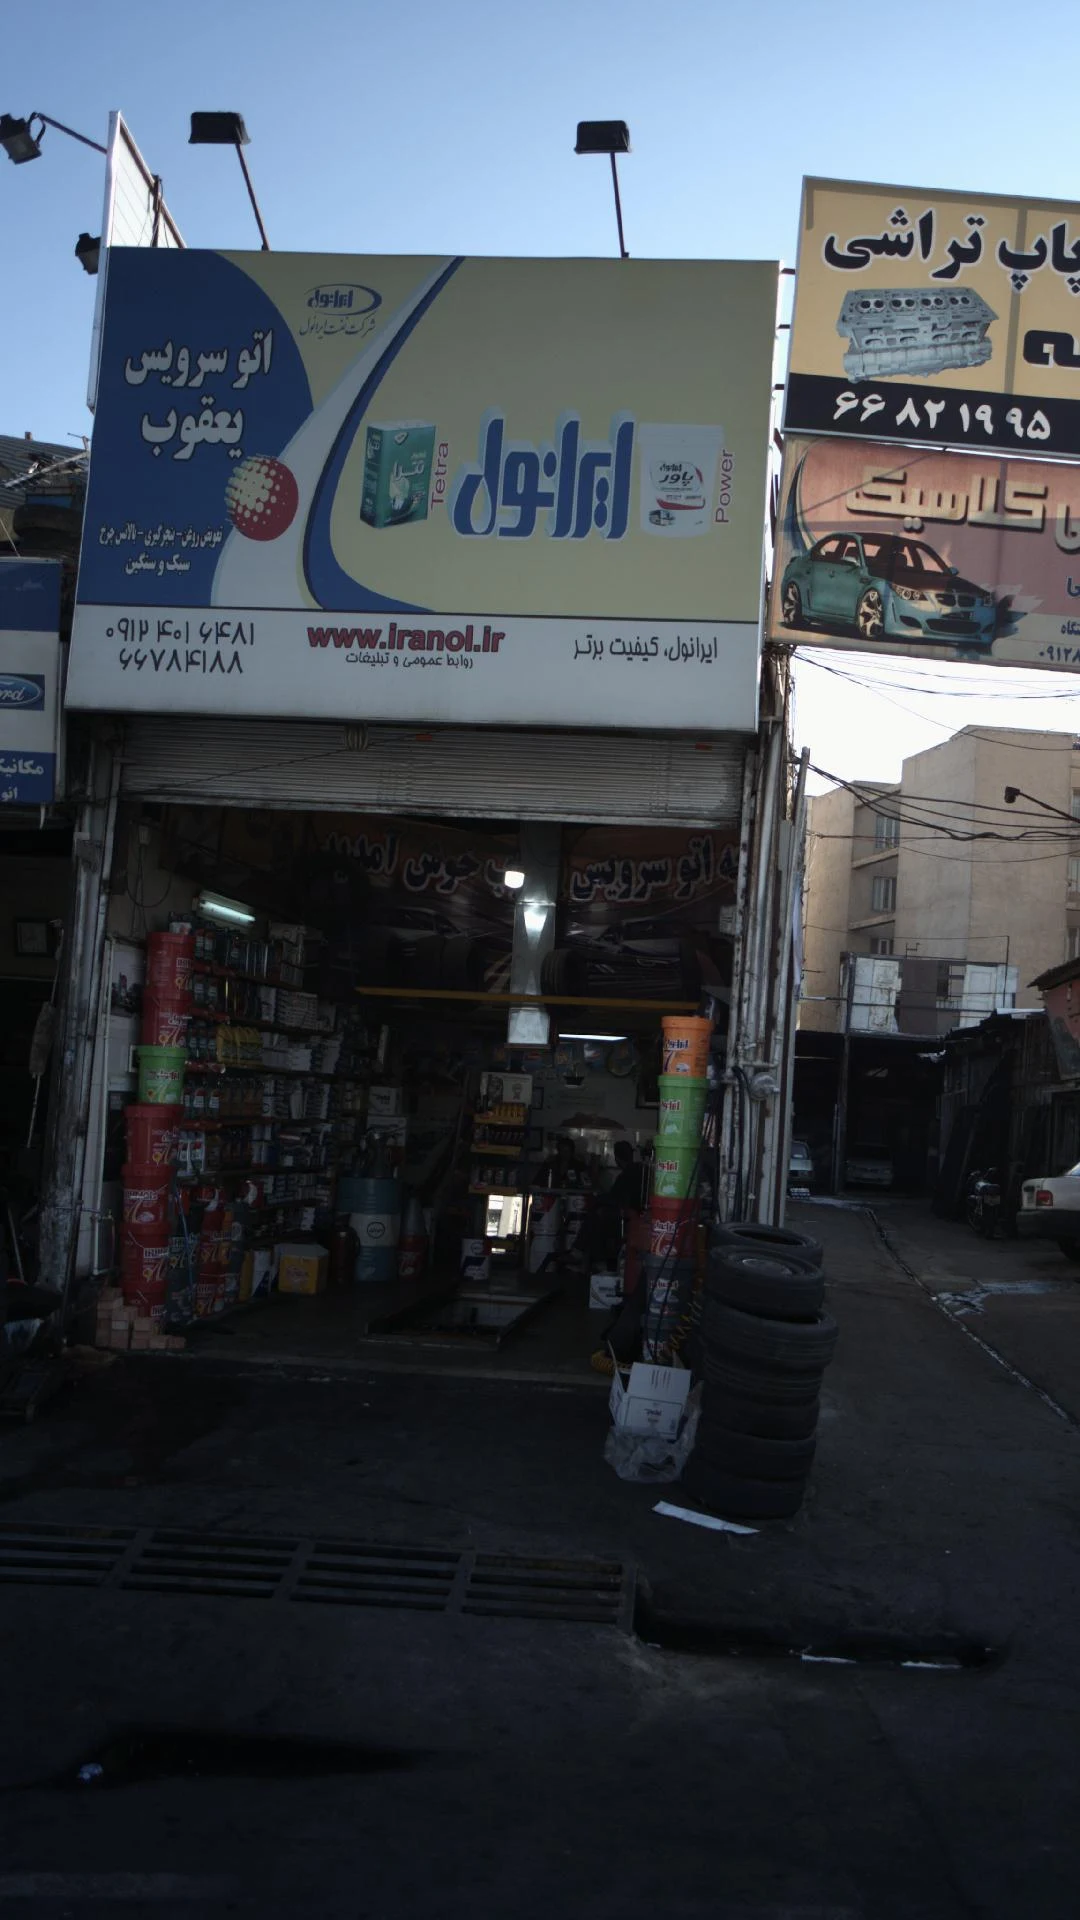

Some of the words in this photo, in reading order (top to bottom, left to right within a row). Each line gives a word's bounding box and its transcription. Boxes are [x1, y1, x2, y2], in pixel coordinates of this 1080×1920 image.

[824, 208, 985, 280] تراشی
[299, 315, 328, 340] ایرانول
[323, 316, 348, 335] نفت
[345, 311, 377, 339] شرکت
[124, 339, 229, 389] سرویس
[231, 329, 273, 389] اتو
[141, 395, 245, 461] یعقوب
[430, 441, 449, 510] Tetra
[452, 416, 635, 540] ایرانول
[658, 471, 694, 487] پاور
[715, 448, 734, 524] Power
[124, 552, 156, 576] سنگین
[157, 560, 165, 577] و
[165, 553, 191, 576] سبک
[306, 622, 506, 653] www.iranol.ir
[573, 634, 604, 660] برتر
[609, 635, 660, 662] کیفیت
[345, 651, 390, 669] تبلیغات
[393, 655, 400, 668] و
[402, 655, 443, 669] عمومی
[446, 654, 474, 669] روابط
[570, 856, 672, 901] سرویس
[673, 835, 714, 899] اتو
